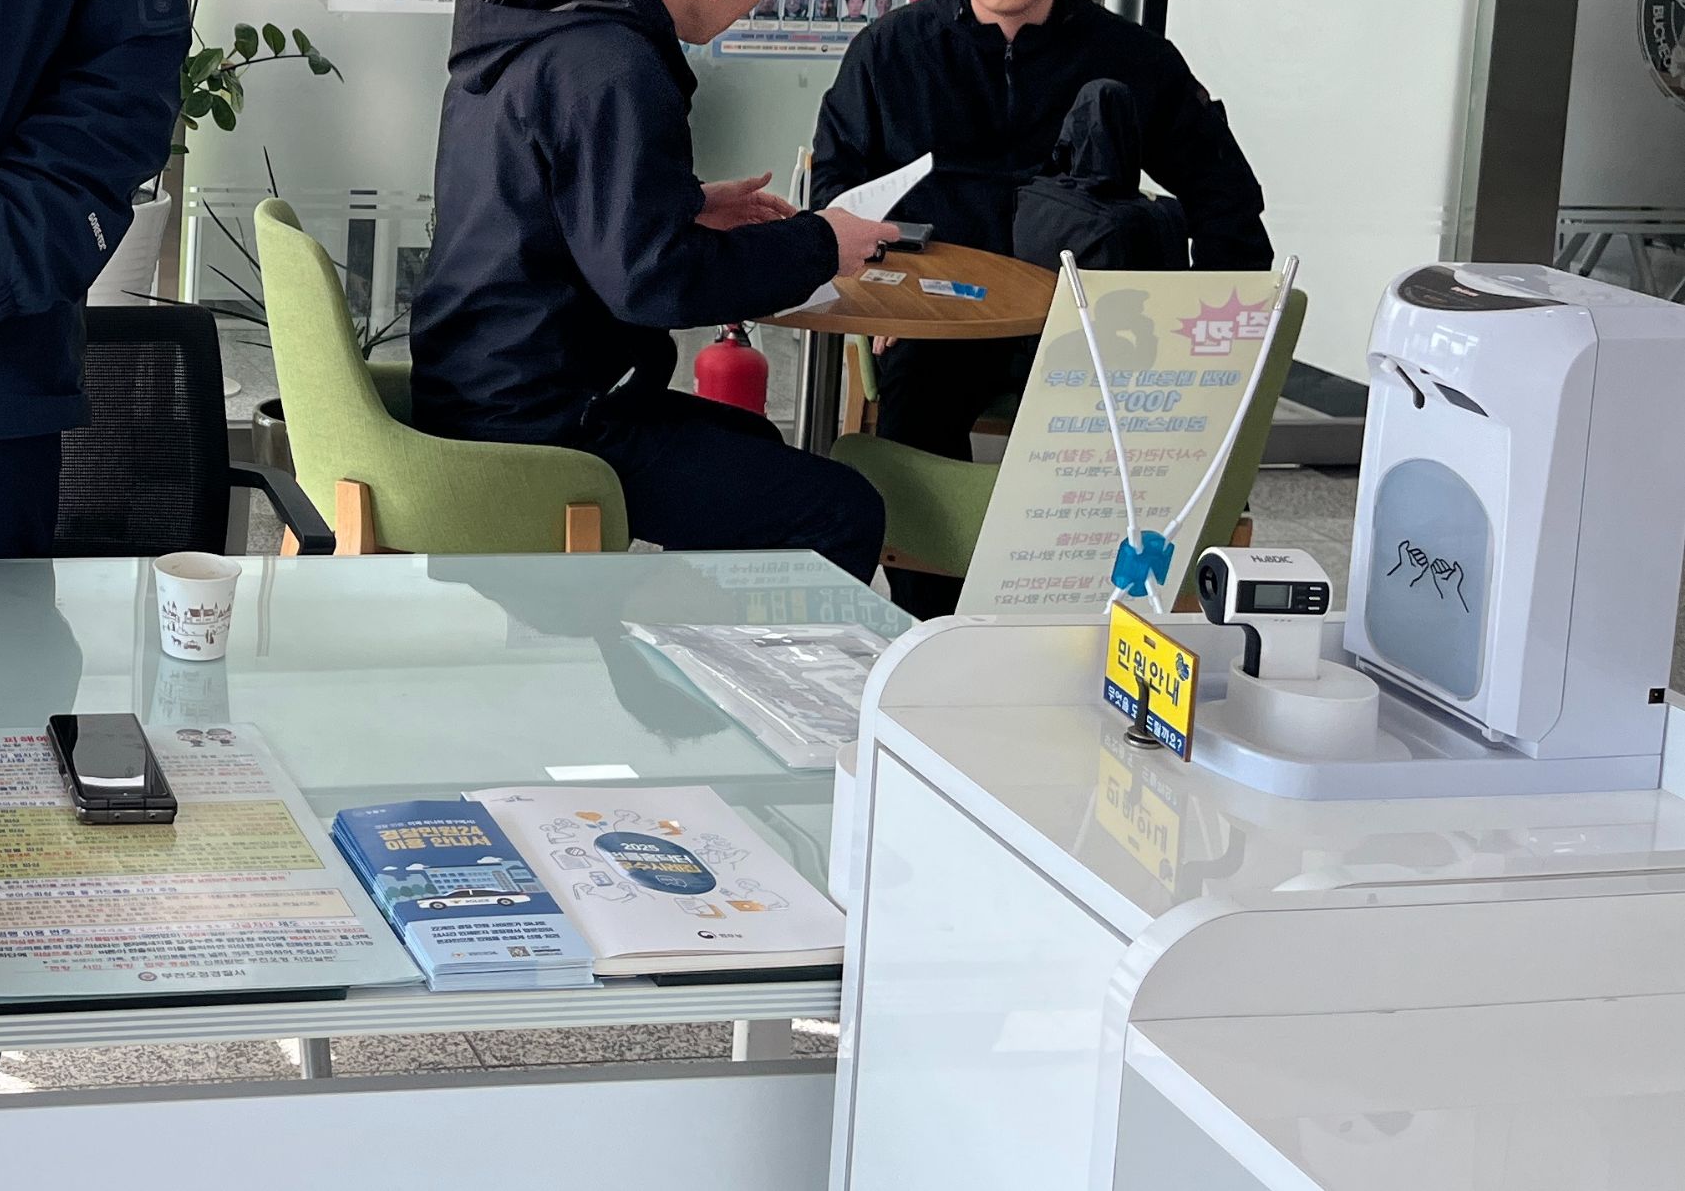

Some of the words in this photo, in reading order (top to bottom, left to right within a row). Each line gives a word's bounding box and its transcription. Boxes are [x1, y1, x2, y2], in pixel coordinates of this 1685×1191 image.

[1118, 638, 1180, 706] 민원안내
[1107, 684, 1130, 714] 무엇을
[1130, 705, 1183, 752] 도드릴까요?
